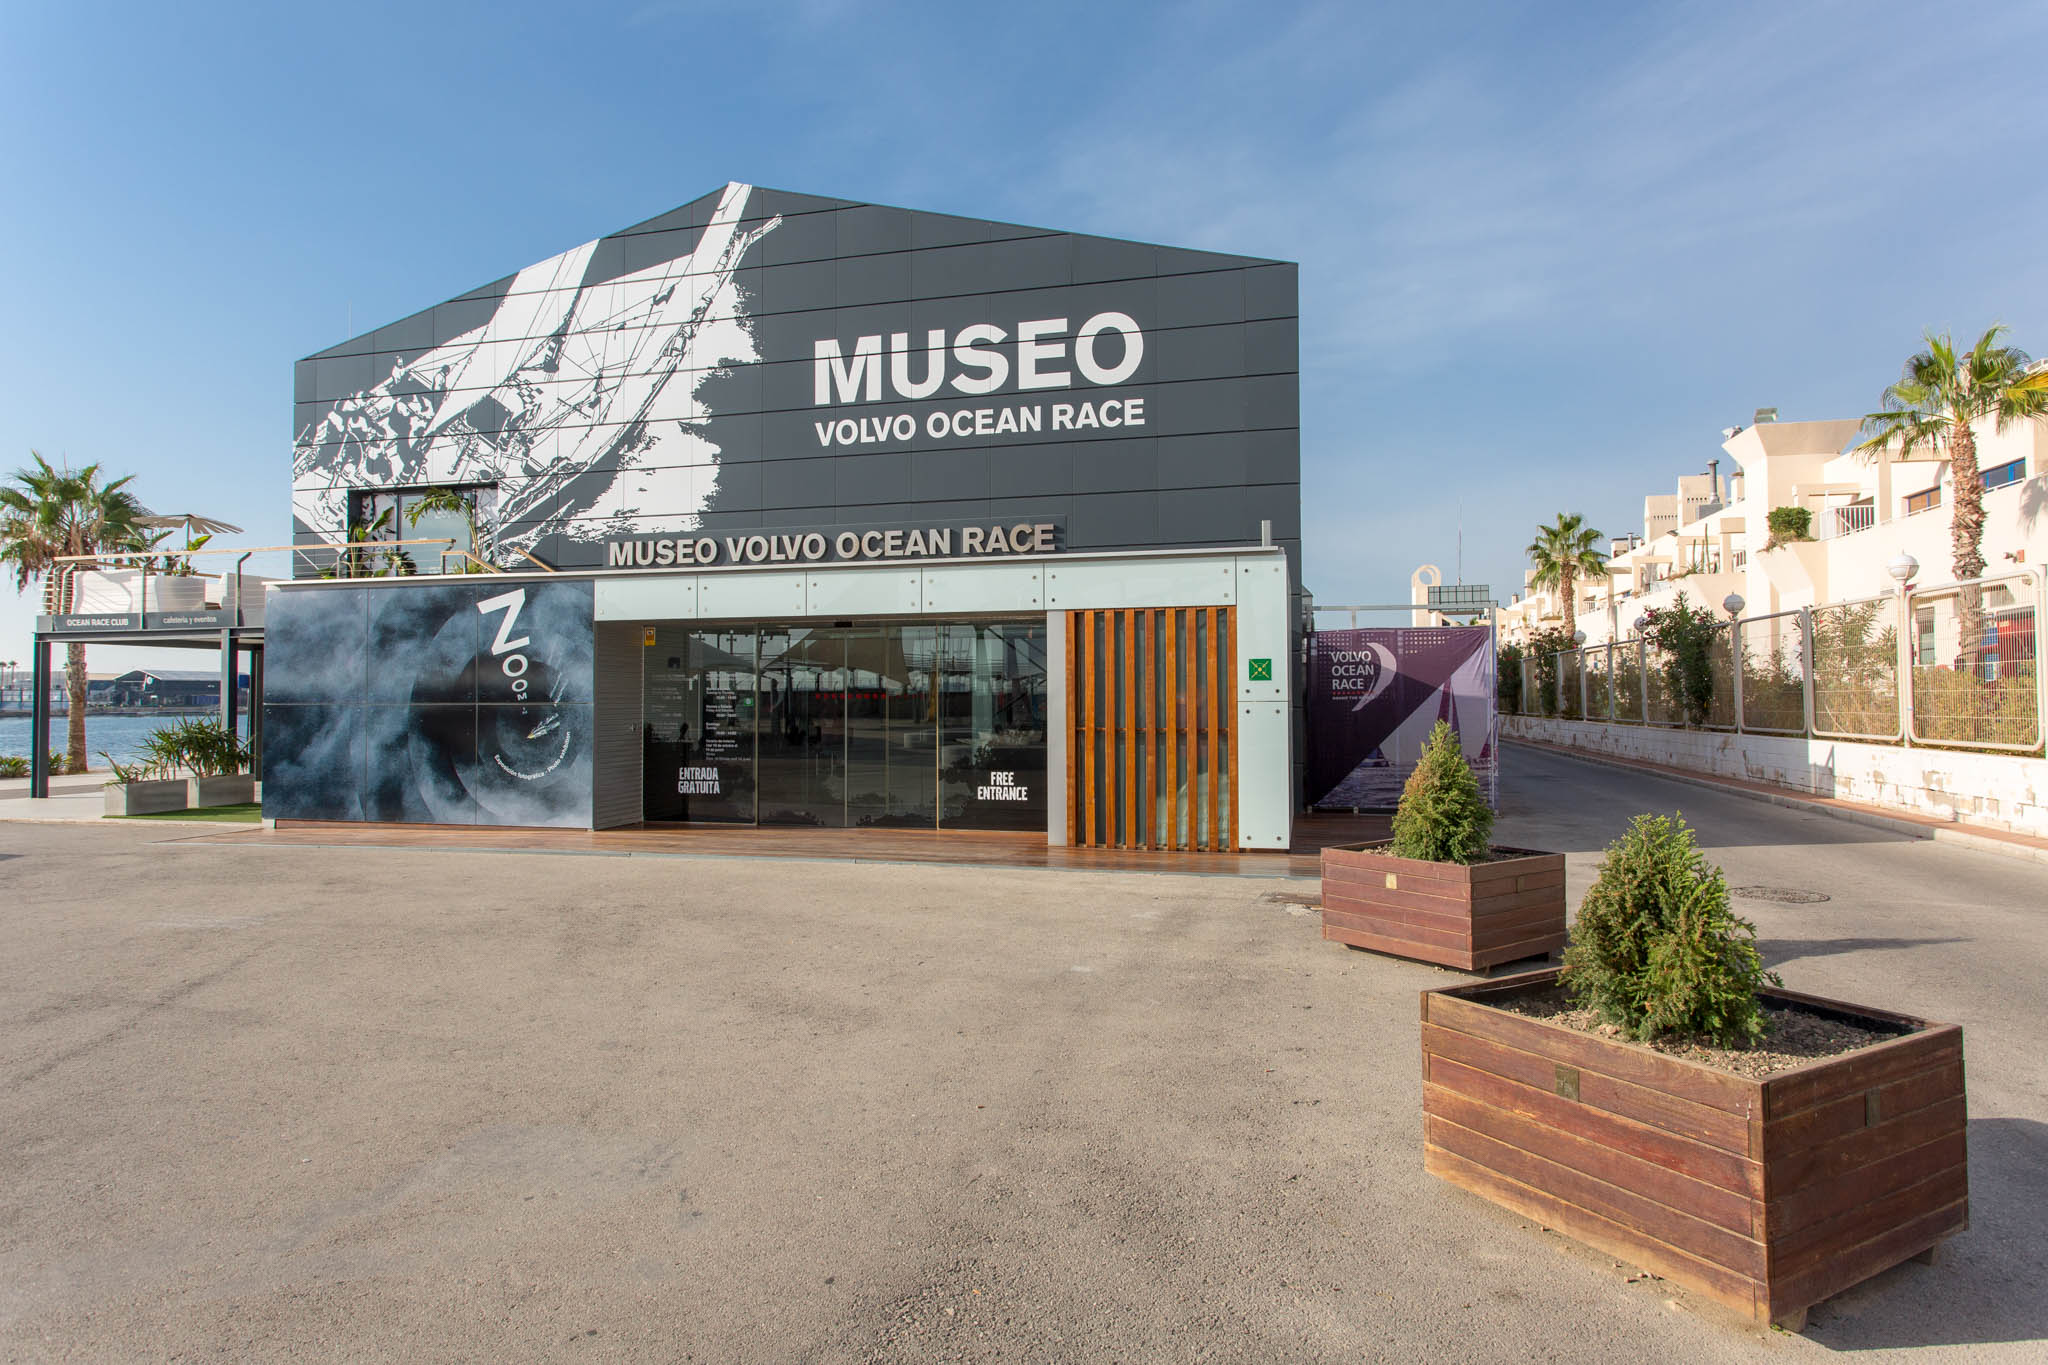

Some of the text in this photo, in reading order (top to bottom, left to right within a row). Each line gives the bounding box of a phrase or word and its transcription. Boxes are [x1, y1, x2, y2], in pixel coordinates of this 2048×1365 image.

[814, 312, 1144, 406] MUSEO
[815, 398, 1145, 447] VOLVO OCEAN RACE
[609, 523, 1056, 567] MUSEO VOLVO OCEAN RACE
[66, 617, 129, 627] OCEAN RACE CLUB
[1331, 651, 1372, 663] VOLVO
[1332, 664, 1374, 676] OCEAN
[1332, 678, 1364, 690] RACE
[679, 767, 719, 780] ENTRADA
[991, 771, 1014, 786] FREE
[678, 781, 720, 794] GRATUITA
[978, 786, 1028, 801] ENTRANCE
